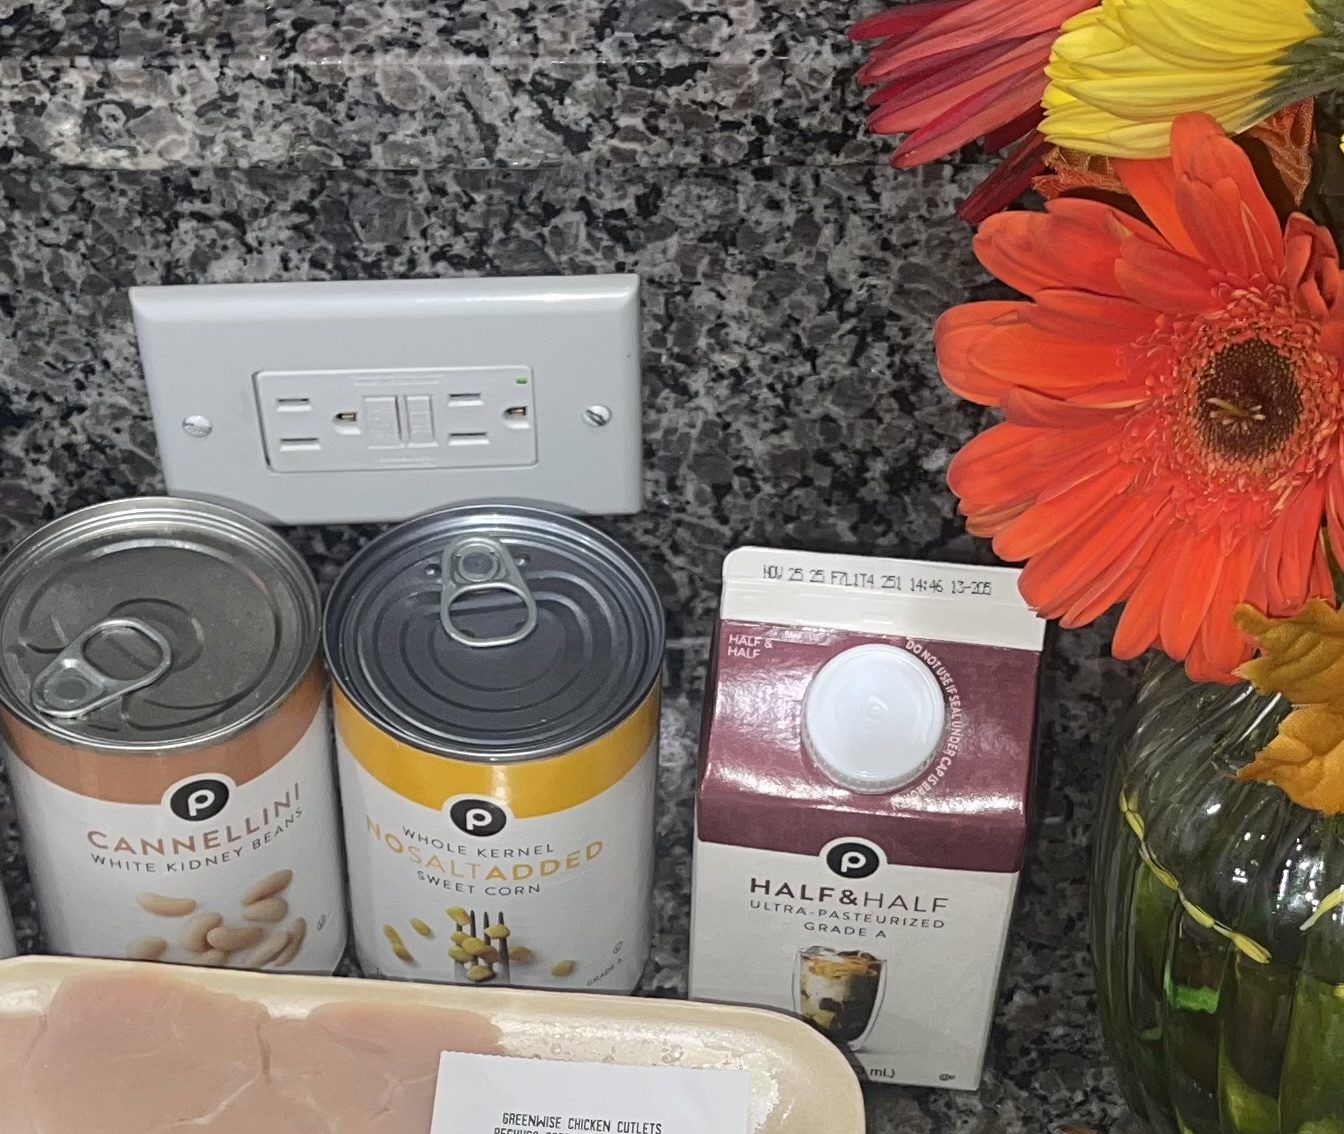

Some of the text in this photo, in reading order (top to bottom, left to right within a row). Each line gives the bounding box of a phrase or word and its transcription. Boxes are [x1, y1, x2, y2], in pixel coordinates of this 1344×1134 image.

[788, 567, 803, 582] 25
[809, 569, 825, 584] 25
[911, 577, 943, 593] 14:46
[87, 782, 300, 856] CANNELLINI
[91, 806, 304, 874] WHITE KIDNEY BEANS
[402, 825, 554, 858] WHOLE KERNEL
[417, 870, 541, 896] SWEET CORN
[749, 900, 945, 929] ULTRA-PASTEURIZED
[804, 921, 887, 939] GRADE A
[502, 1112, 562, 1130] GREENWISE
[567, 1118, 611, 1132] CHICKEN
